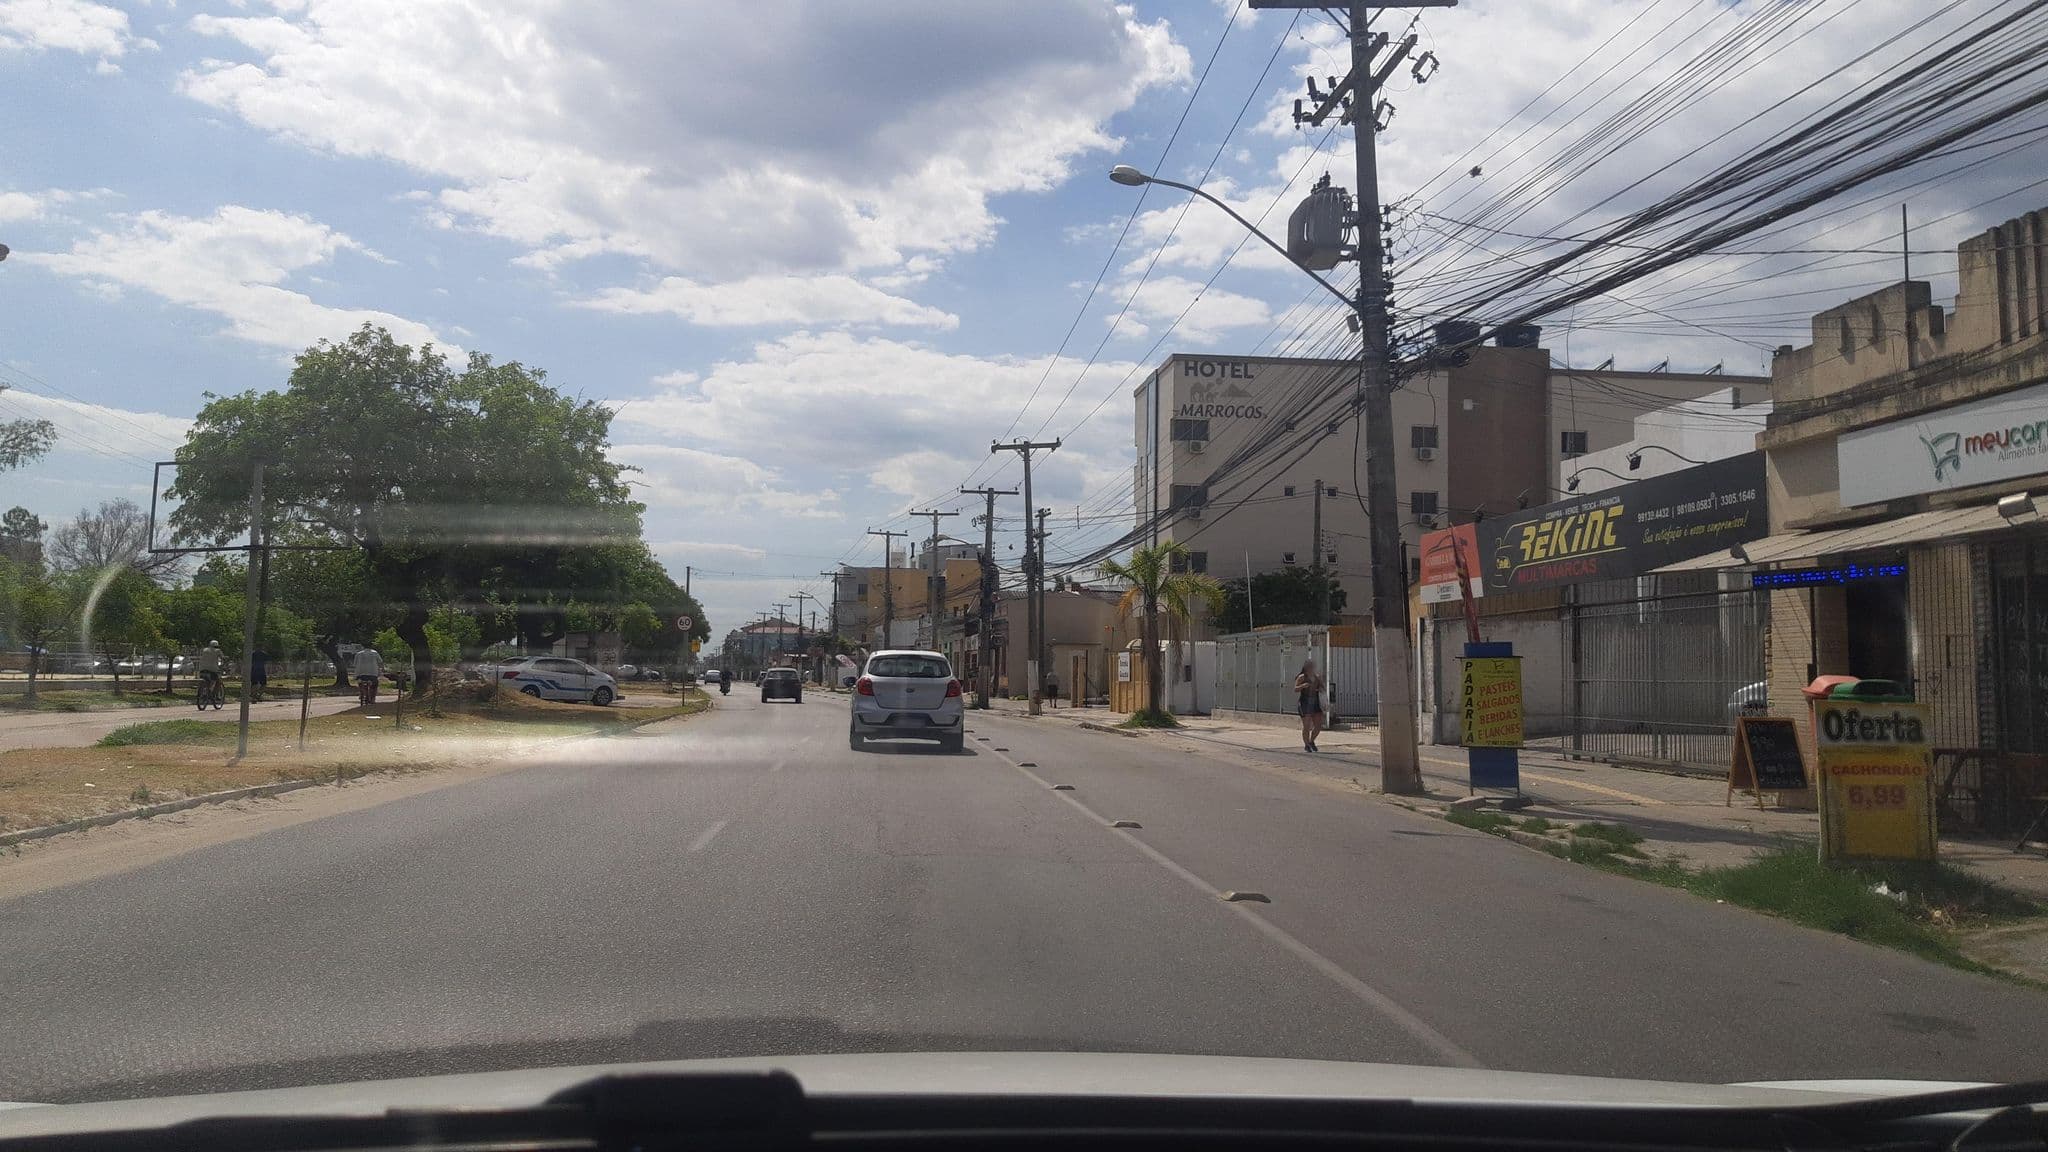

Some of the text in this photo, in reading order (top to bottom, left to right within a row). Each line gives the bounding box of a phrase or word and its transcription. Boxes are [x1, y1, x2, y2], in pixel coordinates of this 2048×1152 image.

[1184, 360, 1254, 379] HOTEL
[1180, 403, 1263, 419] MARROCOS
[1965, 420, 2048, 455] meucar
[1998, 446, 2036, 462] Alimento
[1518, 559, 1598, 584] MULTIMARCAS
[1480, 681, 1516, 697] PASTEIS
[1464, 661, 1474, 743] PADARIA
[1476, 694, 1520, 711] SALGADOS
[1480, 709, 1517, 725] BEBIDAS
[1824, 708, 1924, 742] Oferta
[1485, 723, 1521, 739] LANCHES
